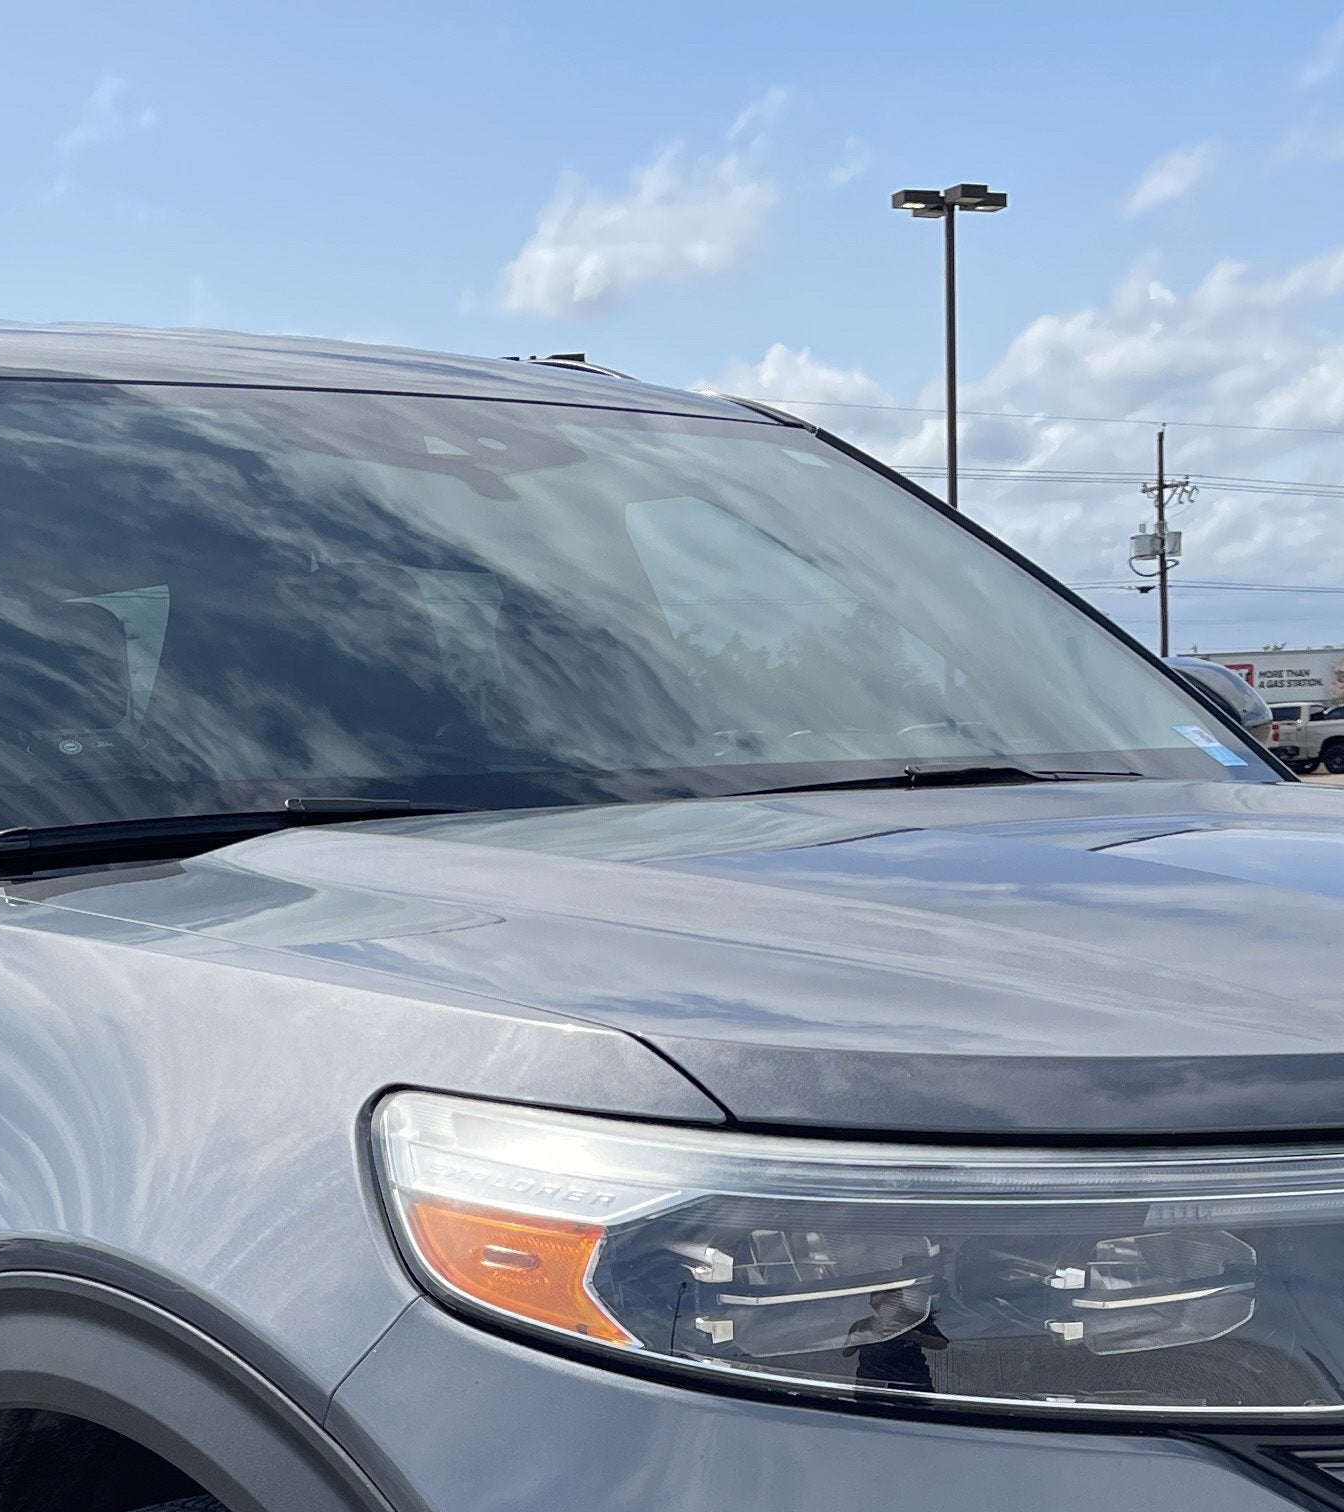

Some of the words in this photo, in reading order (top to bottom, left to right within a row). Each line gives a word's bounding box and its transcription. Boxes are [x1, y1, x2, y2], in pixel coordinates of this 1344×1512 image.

[1259, 670, 1283, 678] MORE
[1287, 669, 1310, 677] THAN
[1259, 680, 1265, 688] A
[1268, 680, 1284, 688] GAS
[425, 1164, 616, 1207] EXPLORER
